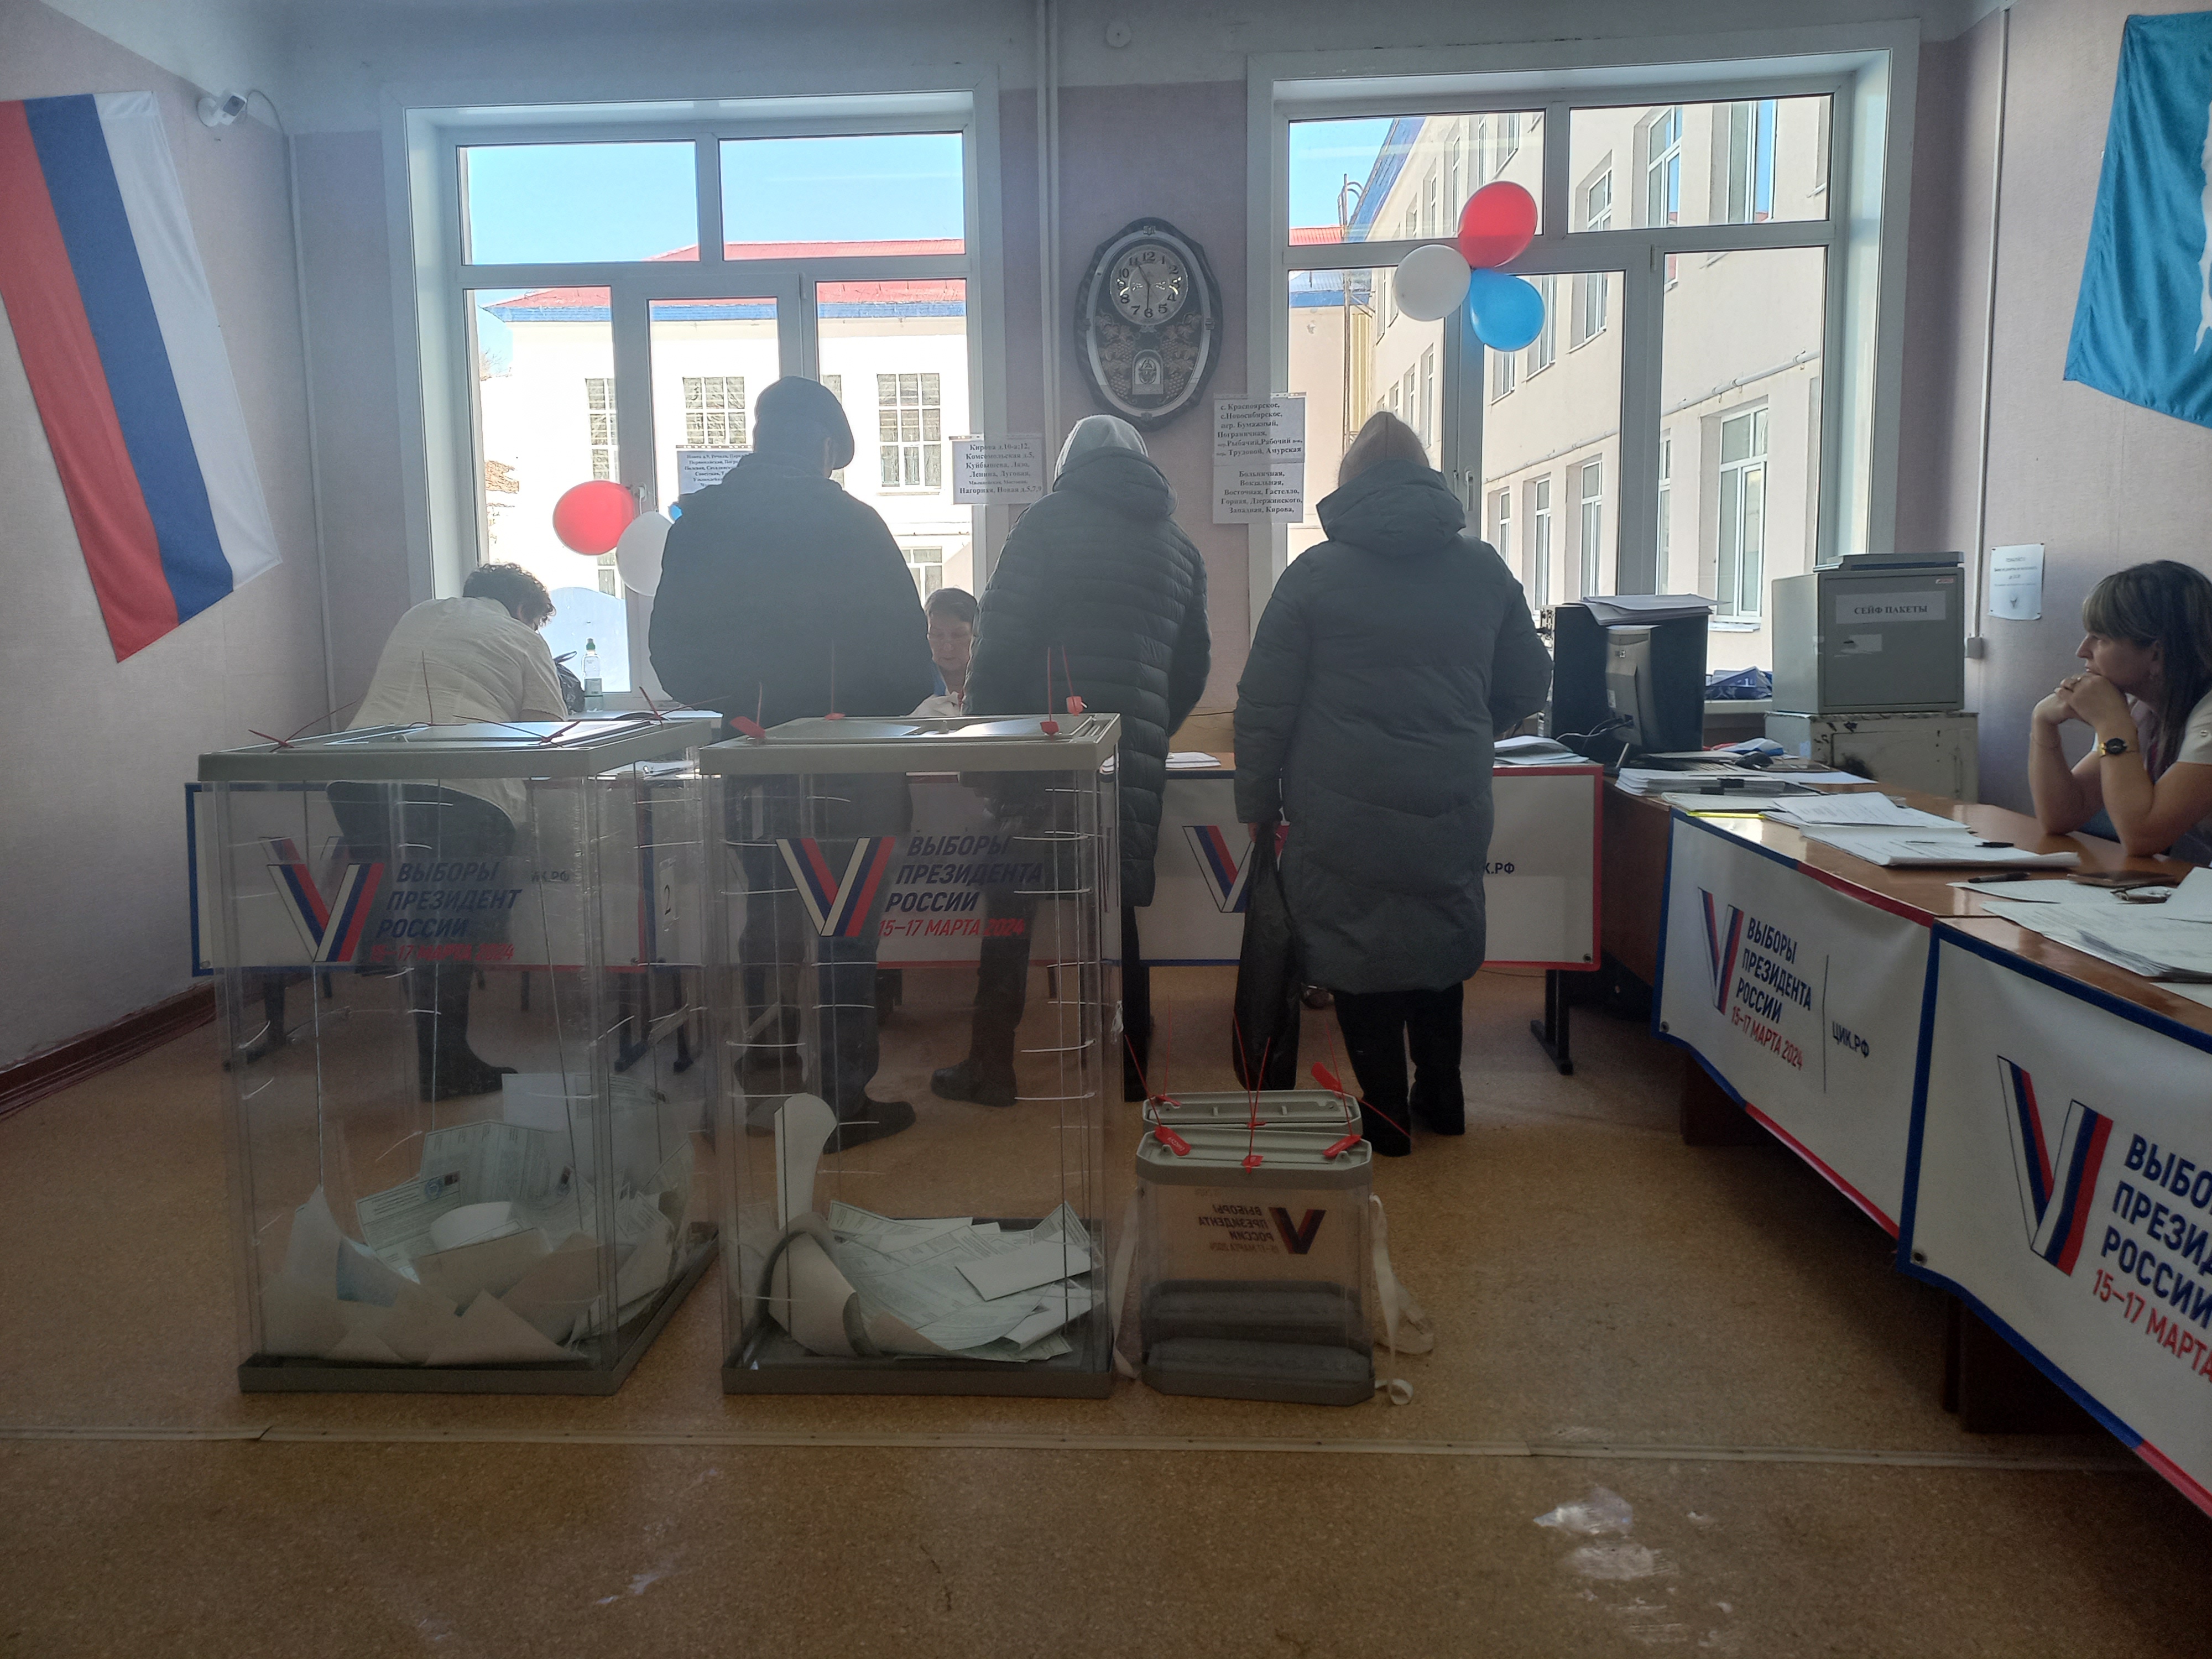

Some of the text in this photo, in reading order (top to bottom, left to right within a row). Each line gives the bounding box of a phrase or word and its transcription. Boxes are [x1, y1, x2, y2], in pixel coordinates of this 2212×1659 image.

[1142, 252, 1156, 262] 12
[1161, 255, 1166, 265] 1
[1119, 268, 1129, 278] 10
[1168, 265, 1179, 275] 2
[1167, 293, 1177, 302] 4
[1130, 305, 1141, 315] 7
[1144, 308, 1154, 319] 6
[1158, 303, 1168, 314] 5
[1266, 447, 1301, 455] Амурская
[1250, 497, 1303, 505] Дзержинского,
[1854, 604, 1928, 615] СЕЙФ ПАКЕТЫ
[907, 836, 1010, 857] ВЫБОРЫ
[397, 862, 500, 883] ВЫБОРЫ
[895, 862, 1043, 886] ПРЕЗИДЕНТА
[885, 891, 980, 912] РОССИИ
[377, 919, 469, 938] РОССИИ
[924, 919, 981, 936] МАРТА
[983, 919, 1025, 936] 2024
[1746, 917, 1797, 964] ВЫБОРЫ
[416, 943, 473, 961] МАРТА
[1742, 948, 1812, 1011] ПРЕЗИДЕНТА
[1736, 977, 1783, 1024] РОССИИ
[1751, 1021, 1782, 1055] МАРТА
[1782, 1040, 1803, 1071] 2024
[1832, 1021, 1870, 1058] ЦИК.РФ
[2124, 1133, 2212, 1215] ВЫБО
[2101, 1225, 2212, 1329] РОССИИ
[2145, 1307, 2212, 1383] МАРТА
